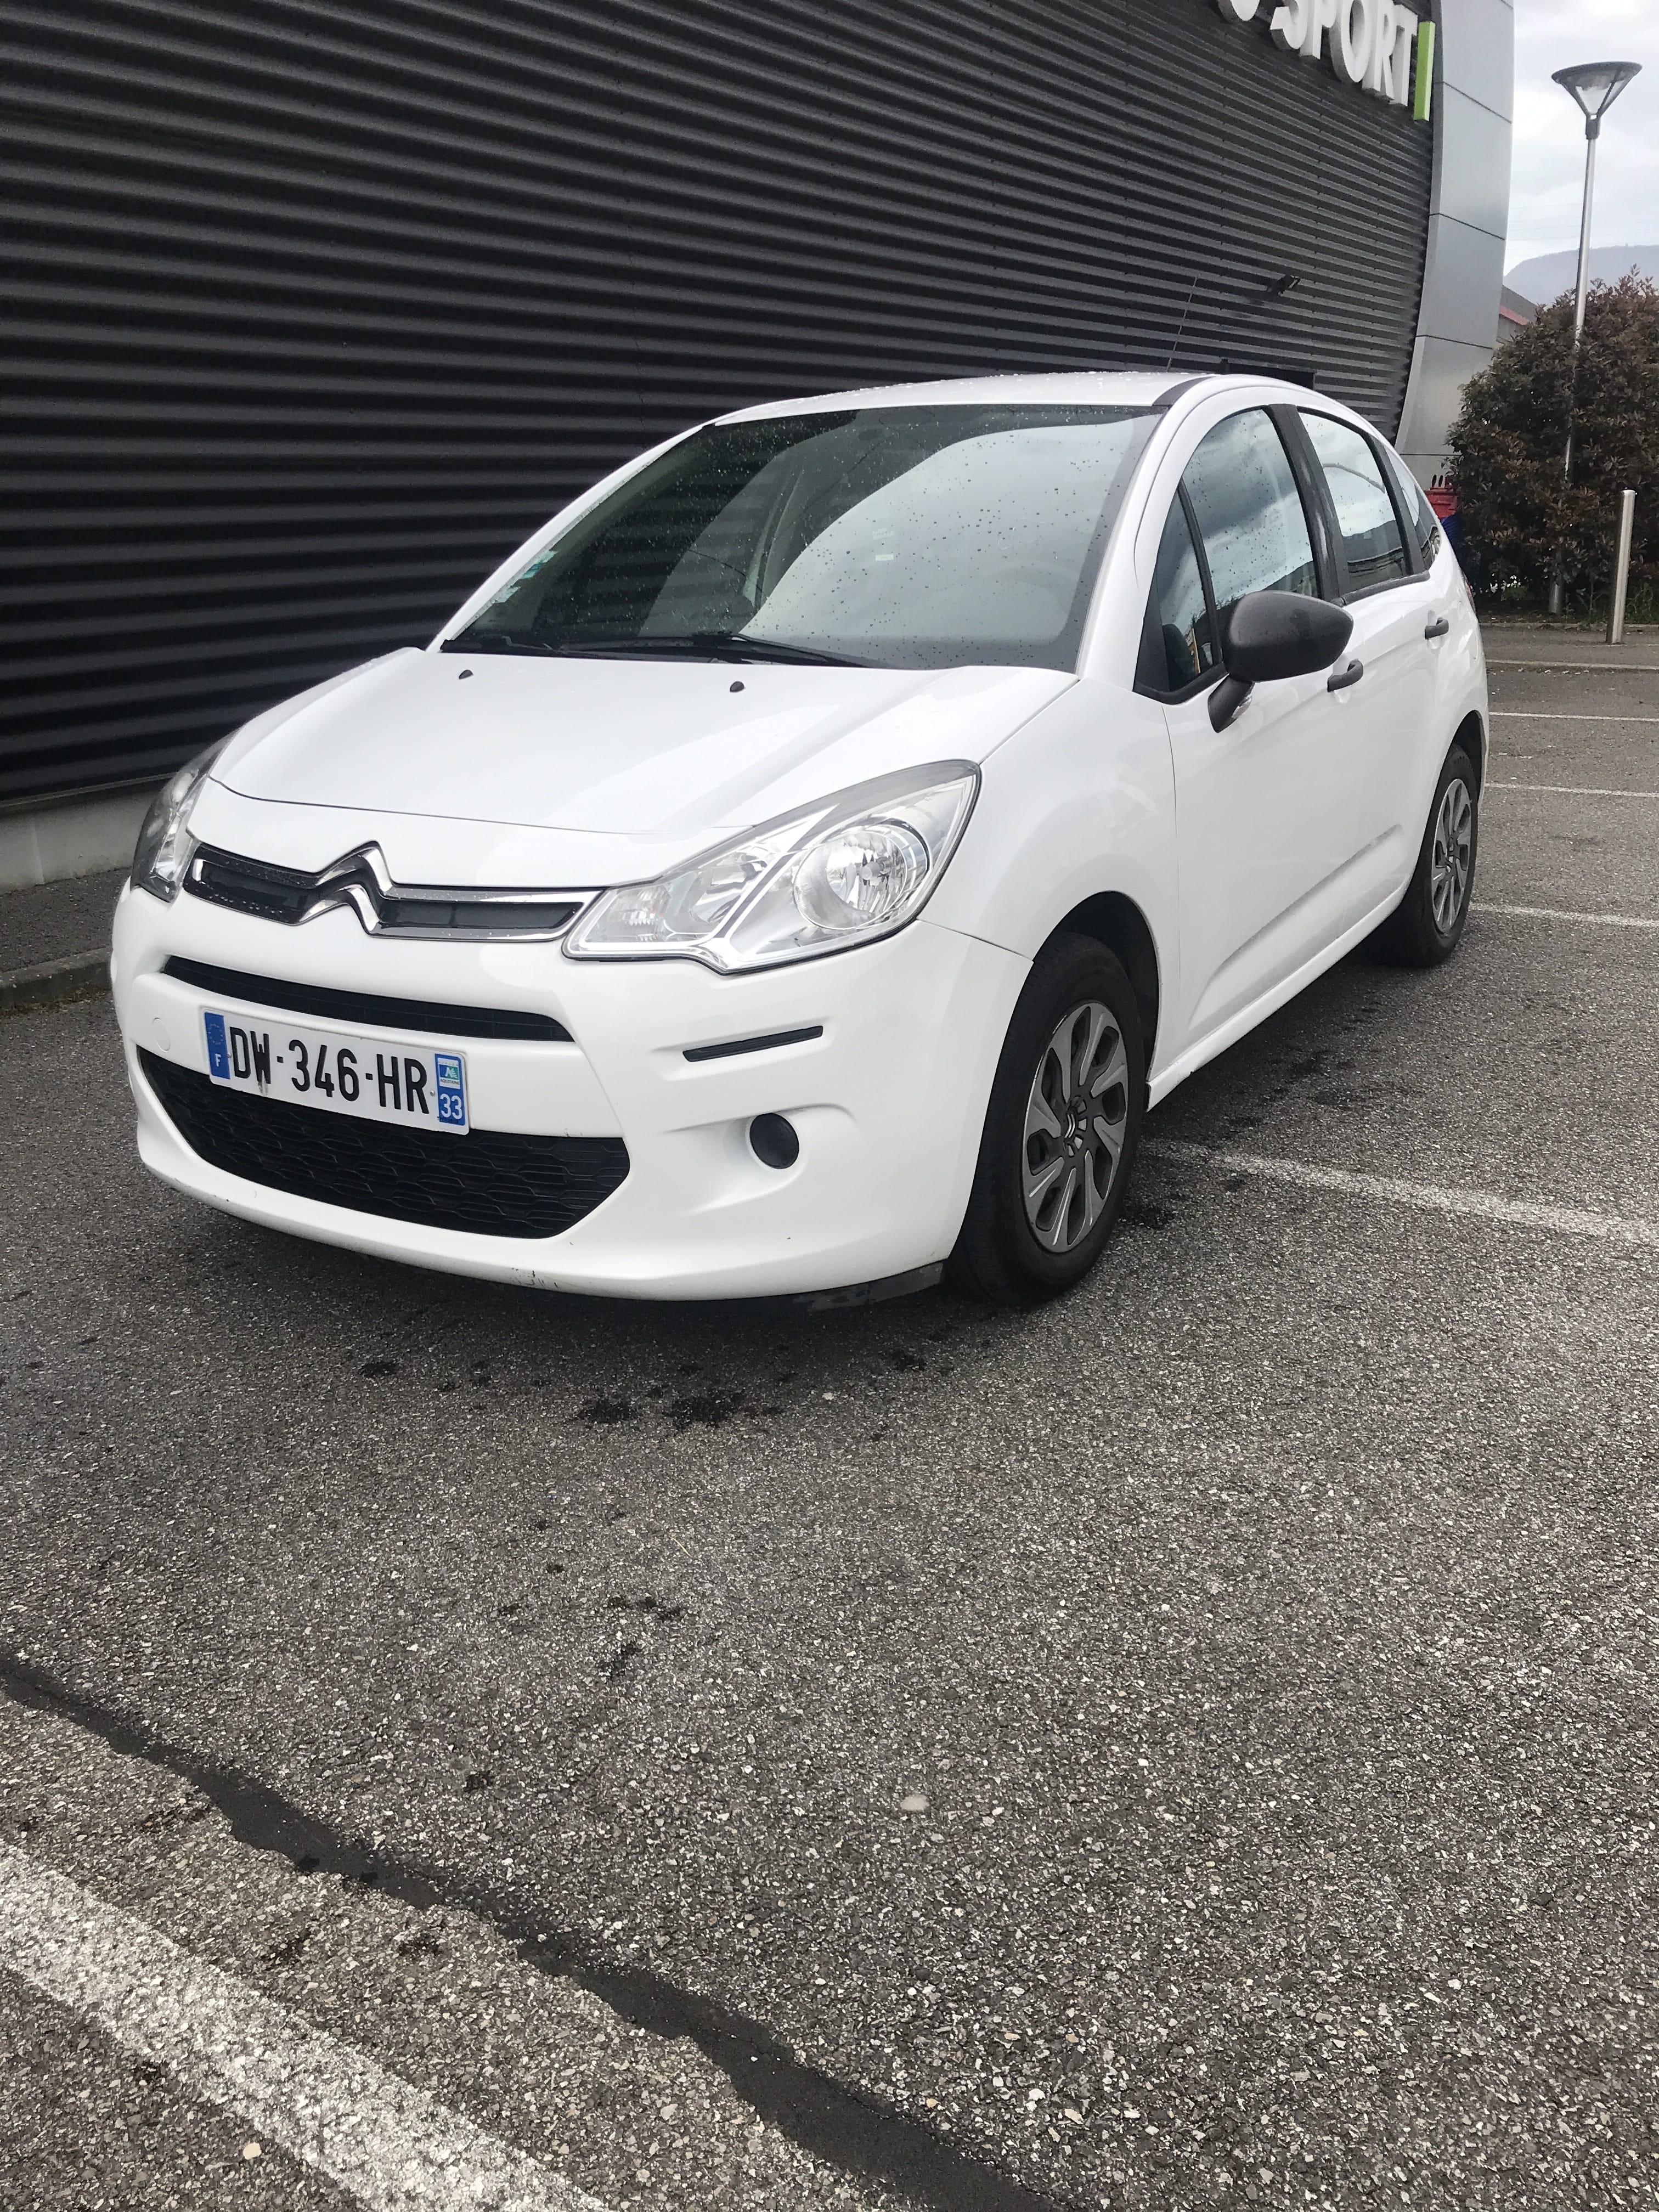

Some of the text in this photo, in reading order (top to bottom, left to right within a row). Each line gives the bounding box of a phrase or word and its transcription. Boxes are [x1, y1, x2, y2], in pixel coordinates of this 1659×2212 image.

[215, 1053, 222, 1068] F
[229, 1026, 430, 1114] DW-346-HR
[439, 1093, 462, 1120] 33
